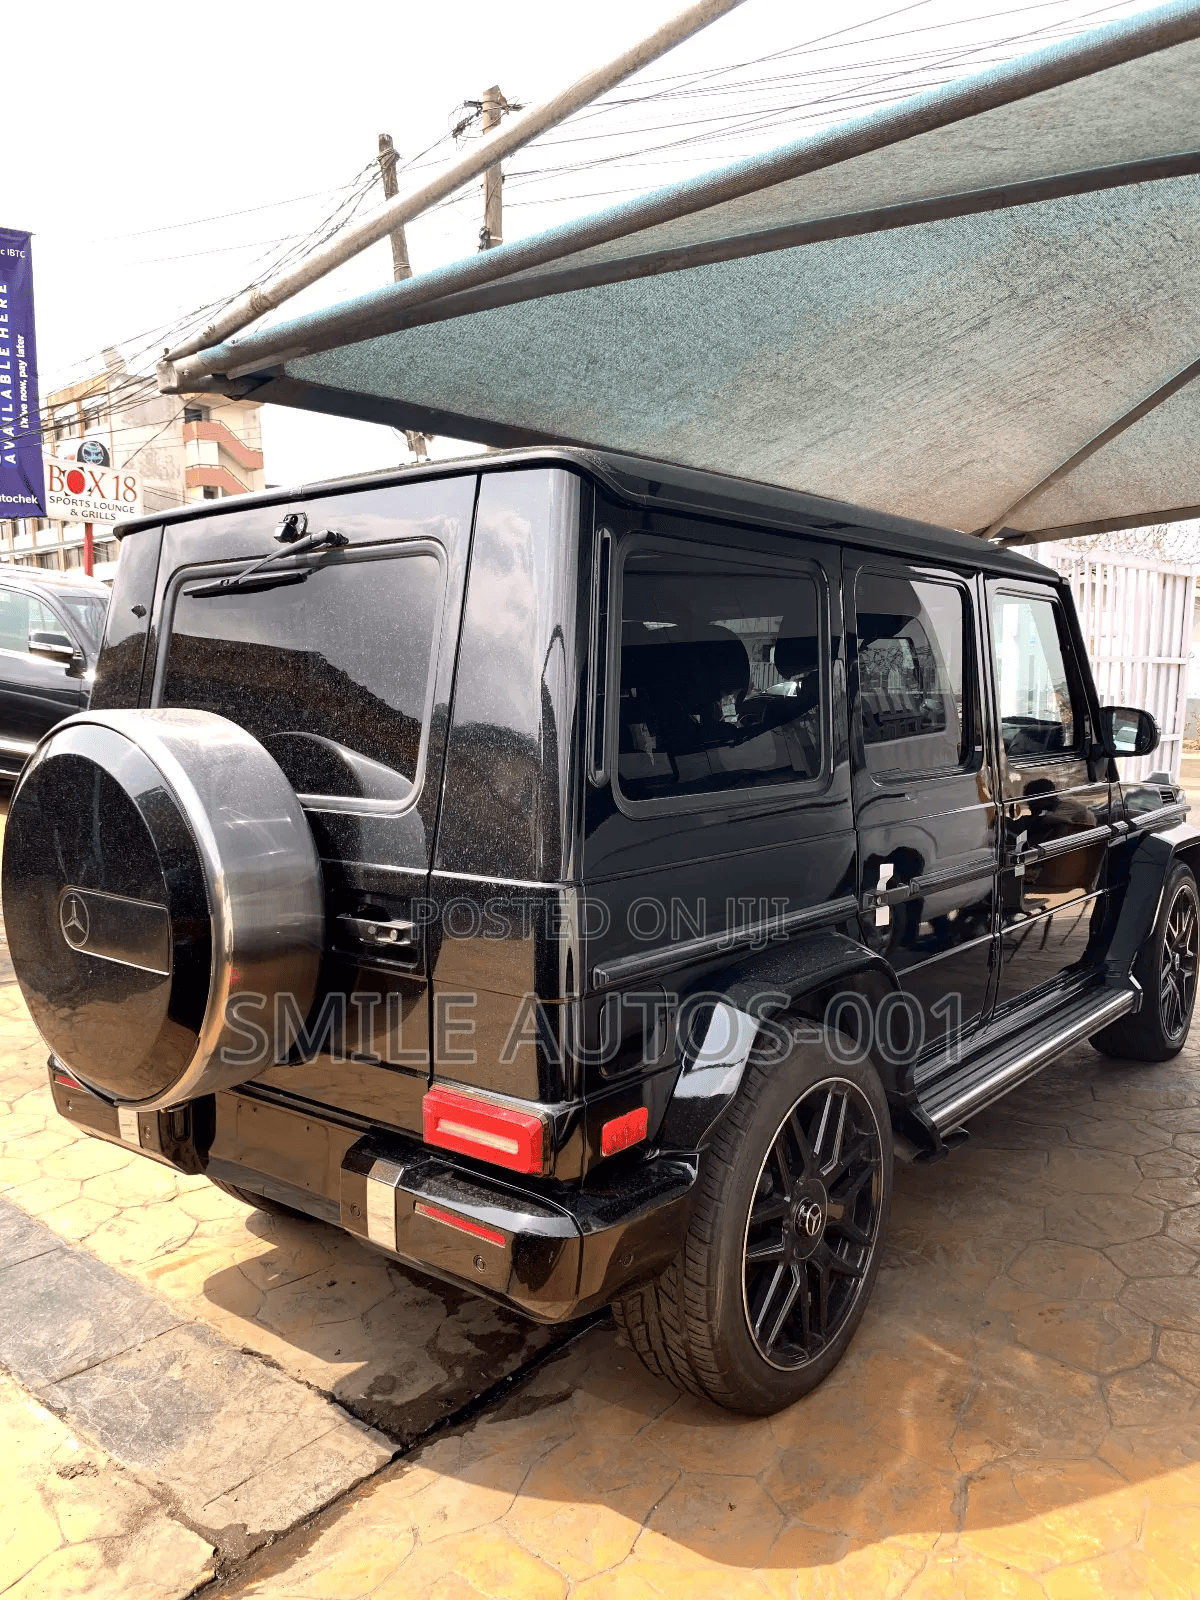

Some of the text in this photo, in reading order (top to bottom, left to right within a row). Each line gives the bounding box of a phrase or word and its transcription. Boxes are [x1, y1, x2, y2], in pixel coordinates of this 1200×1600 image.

[7, 248, 26, 258] IBTC
[16, 333, 26, 358] later
[0, 284, 16, 465] AVAILABLE HERE
[19, 360, 28, 378] pay
[20, 403, 29, 429] Drive
[48, 464, 137, 503] BOX 18
[49, 495, 135, 514] SPORTS LOUNGE
[70, 508, 116, 521] & GRILLS
